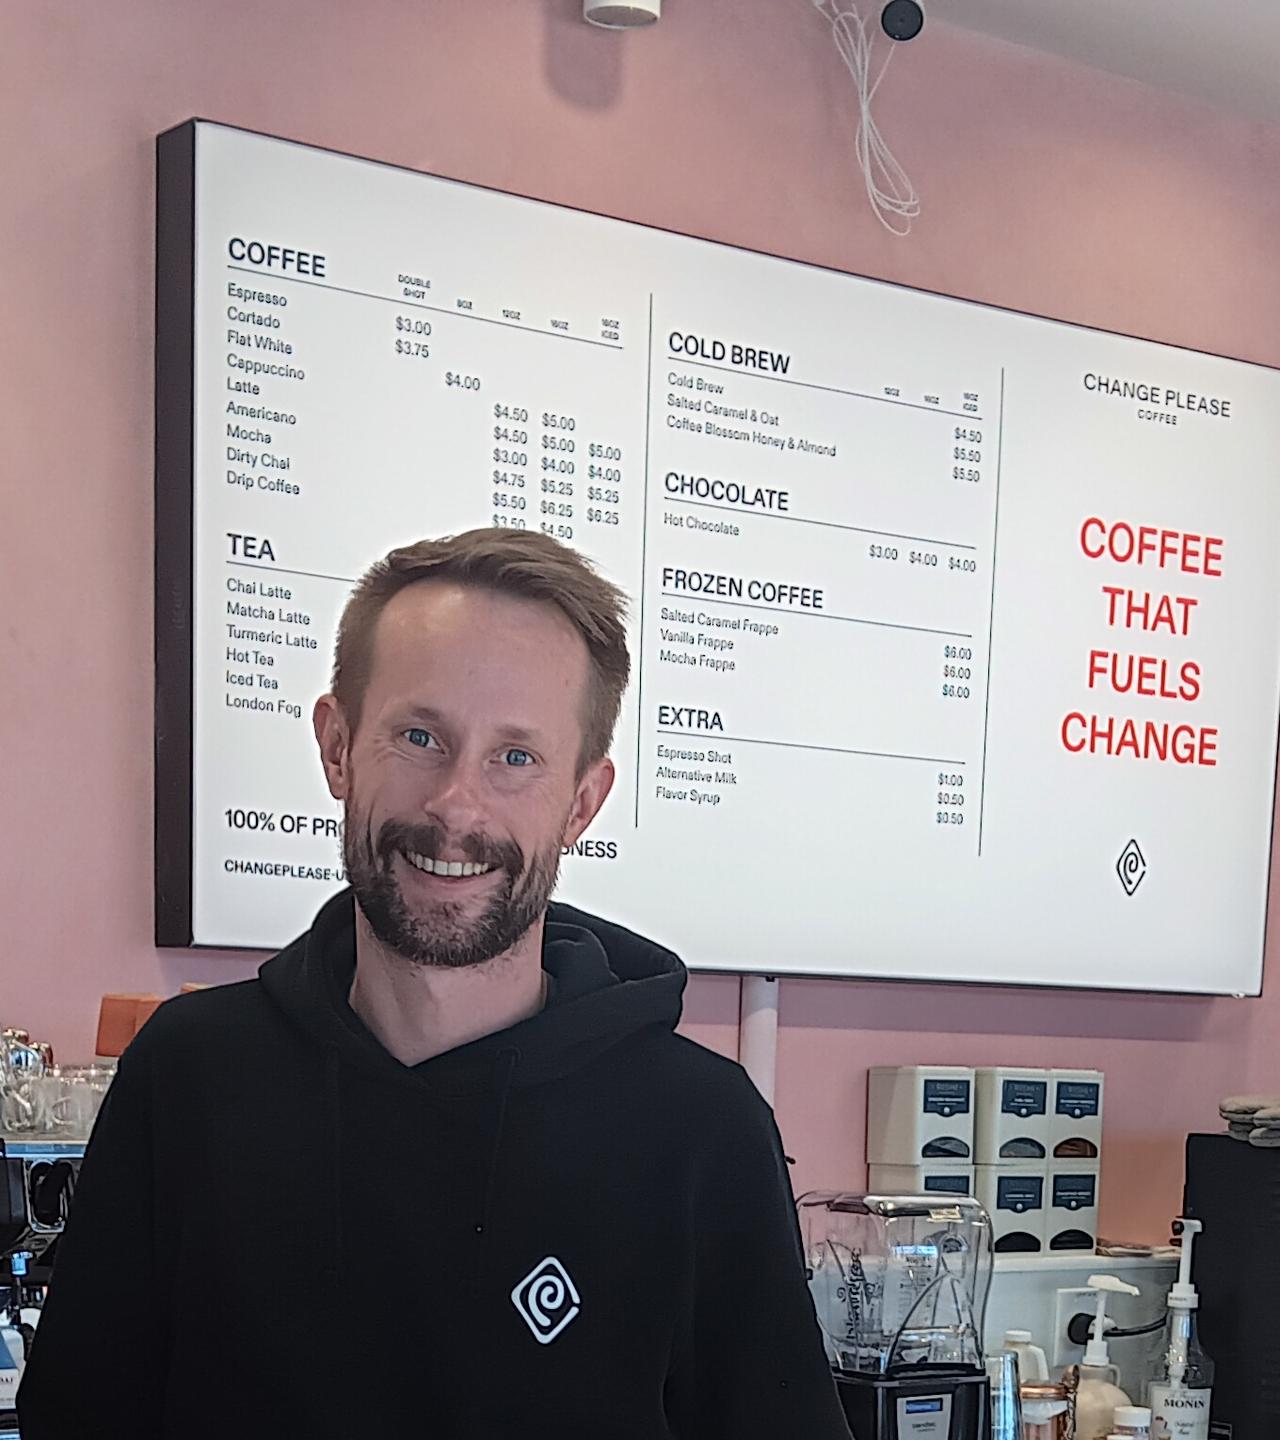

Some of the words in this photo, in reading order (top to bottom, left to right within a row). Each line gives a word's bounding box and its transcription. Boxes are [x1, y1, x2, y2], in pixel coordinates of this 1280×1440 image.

[228, 237, 326, 277] COFFEE
[227, 282, 288, 307] Espresso
[227, 305, 281, 329] Cortado
[396, 315, 432, 336] $3.00
[227, 329, 252, 348] Flat
[254, 334, 293, 355] White
[395, 338, 430, 359] $3.75
[668, 331, 726, 361] COLD
[731, 344, 790, 374] BREW
[226, 353, 305, 381] Cappuccino
[227, 377, 260, 396] Latte
[445, 371, 481, 391] $4.00
[667, 372, 694, 389] Cold
[696, 377, 724, 395] Brew
[1083, 373, 1161, 404] CHANGE
[1165, 389, 1231, 418] PLEASE
[225, 400, 297, 425] Americano
[494, 403, 529, 423] $4.50
[542, 412, 576, 432] $5.00
[667, 392, 702, 412] Salted
[703, 400, 748, 421] Caramel
[749, 409, 758, 423] &
[760, 411, 779, 427] Oat
[1137, 409, 1177, 426] COFFEE
[226, 423, 272, 444] Mocha
[493, 425, 528, 445] $4.50
[541, 434, 575, 453] $5.00
[588, 443, 622, 461] $5.00
[666, 414, 703, 433] Coffee
[704, 421, 750, 441] Blossom
[752, 431, 786, 451] Honey
[787, 437, 795, 450] &
[796, 439, 837, 457] Almond
[954, 427, 982, 444] $4.50
[226, 446, 258, 469] Dirty
[260, 453, 290, 470] Chai
[493, 447, 528, 467] $3.00
[541, 456, 575, 475] $4.00
[588, 464, 621, 483] $4.00
[953, 446, 981, 463] $5.50
[226, 470, 255, 491] Drip
[257, 475, 300, 495] Coffee
[493, 469, 526, 489] $4.75
[541, 478, 574, 497] $5.25
[587, 486, 620, 504] $5.25
[952, 466, 980, 483] $5.50
[665, 472, 789, 511] CHOCOLATE
[493, 492, 527, 511] $5.50
[540, 500, 573, 518] $6.25
[587, 507, 619, 526] $6.25
[663, 512, 684, 528] Hot
[686, 515, 740, 536] Chocolate
[226, 532, 275, 562] TEA
[869, 544, 899, 561] $3.00
[909, 551, 938, 567] $4.00
[948, 556, 977, 573] $4.00
[1080, 517, 1223, 577] COFFEE
[226, 577, 256, 595] Chai
[259, 583, 292, 601] Latte
[662, 567, 743, 598] FROZEN
[747, 580, 823, 609] COFFEE
[226, 601, 275, 621] Matcha
[278, 608, 311, 626] Latte
[660, 607, 695, 624] Salted
[697, 612, 741, 630] Caramel
[742, 618, 779, 637] Frappe
[1102, 586, 1198, 636] THAT
[226, 623, 282, 645] Turmeric
[285, 632, 318, 650] Latte
[660, 628, 695, 645] Vanilla
[697, 633, 734, 652] Frappe
[226, 646, 250, 664] Hot
[252, 650, 274, 667] Tea
[659, 649, 697, 666] Mocha
[699, 654, 736, 673] Frappe
[944, 645, 972, 661] $6.00
[226, 670, 254, 687] Iced
[256, 674, 279, 690] Tea
[943, 664, 971, 680] $6.00
[1088, 650, 1200, 702] FUELS
[942, 683, 970, 699] $6.00
[225, 693, 274, 712] London
[277, 699, 302, 719] Fog
[658, 705, 724, 731] EXTRA
[1061, 712, 1218, 766] CHANGE
[657, 744, 705, 762] Espresso
[707, 750, 732, 764] Shot
[655, 766, 713, 783] Alternative
[714, 771, 737, 785] Milk
[938, 772, 964, 787] $1.00
[656, 785, 688, 801] Flavor
[689, 788, 721, 806] Syrup
[937, 791, 965, 806] $0.50
[225, 809, 276, 832] 100%
[280, 814, 308, 834] OF
[312, 817, 343, 837] PR
[936, 811, 964, 825] $0.50
[1164, 1399, 1205, 1409] MONIN
